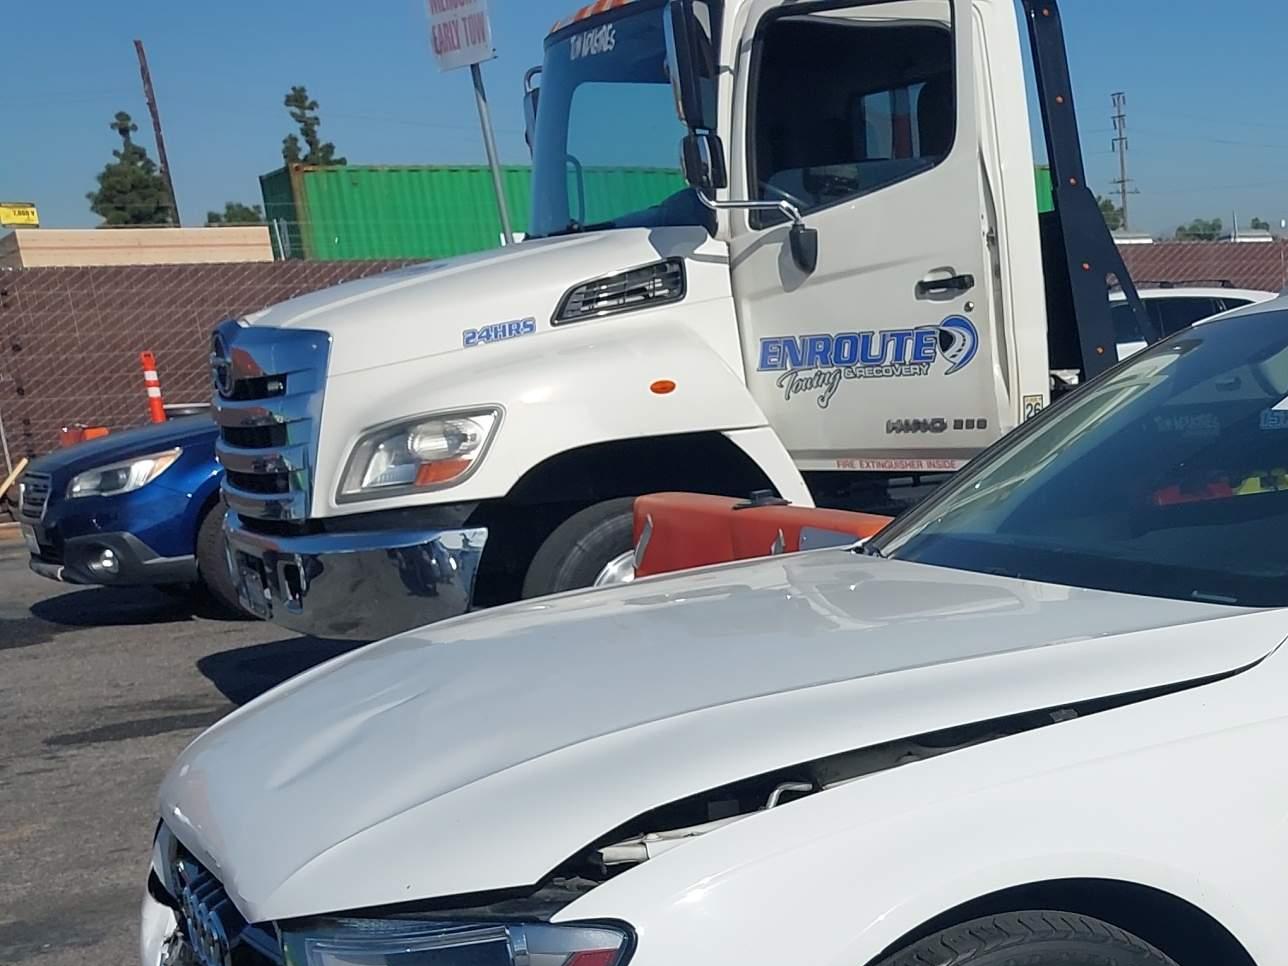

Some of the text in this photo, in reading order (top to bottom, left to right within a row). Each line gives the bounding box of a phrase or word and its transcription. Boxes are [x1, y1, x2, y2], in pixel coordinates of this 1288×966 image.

[463, 316, 536, 348] 24HRS
[756, 330, 938, 372] ENROUTE
[776, 367, 842, 409] Towing
